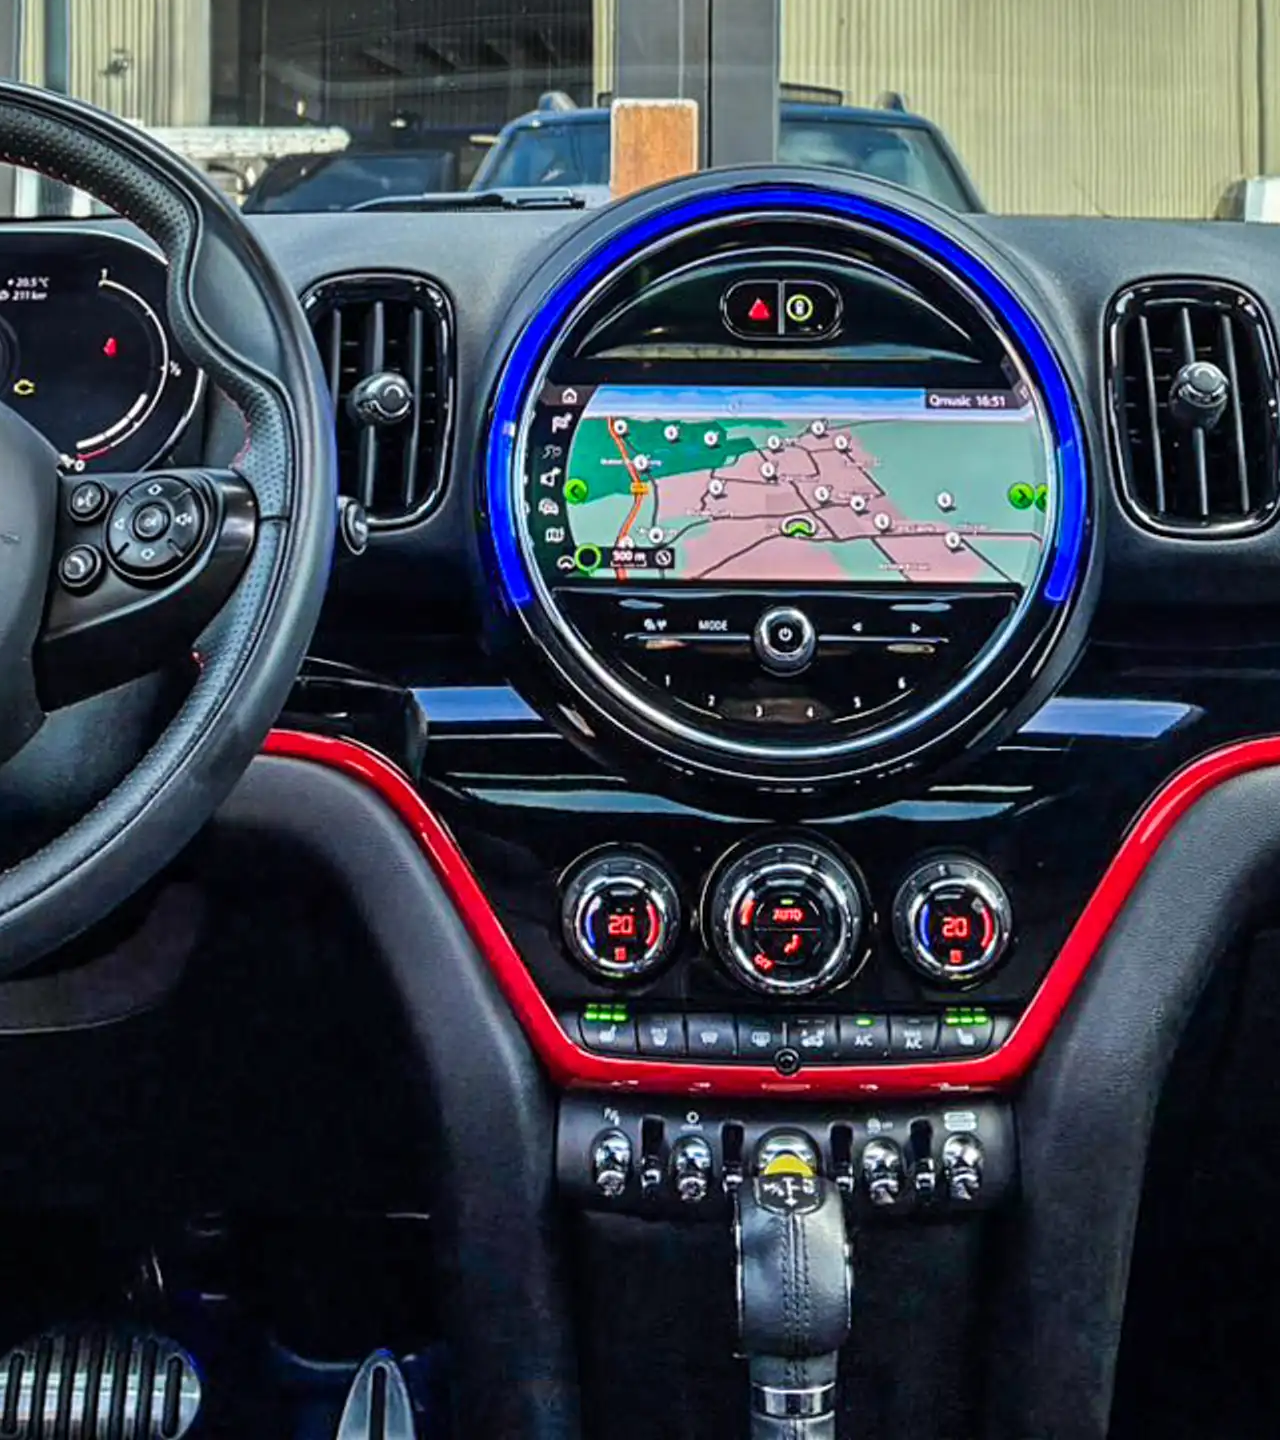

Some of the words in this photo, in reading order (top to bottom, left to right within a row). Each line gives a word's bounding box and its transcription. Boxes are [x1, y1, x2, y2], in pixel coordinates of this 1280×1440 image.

[928, 395, 971, 407] Qmusic
[975, 395, 1006, 407] 16:51
[698, 619, 729, 632] MODE
[664, 674, 671, 688] 1
[898, 676, 906, 689] 6
[707, 695, 716, 707] 2
[853, 696, 862, 709] 5
[755, 705, 764, 719] 3
[806, 705, 815, 719] 4
[772, 908, 804, 922] AUTO
[608, 914, 635, 935] 20
[941, 916, 969, 938] 20
